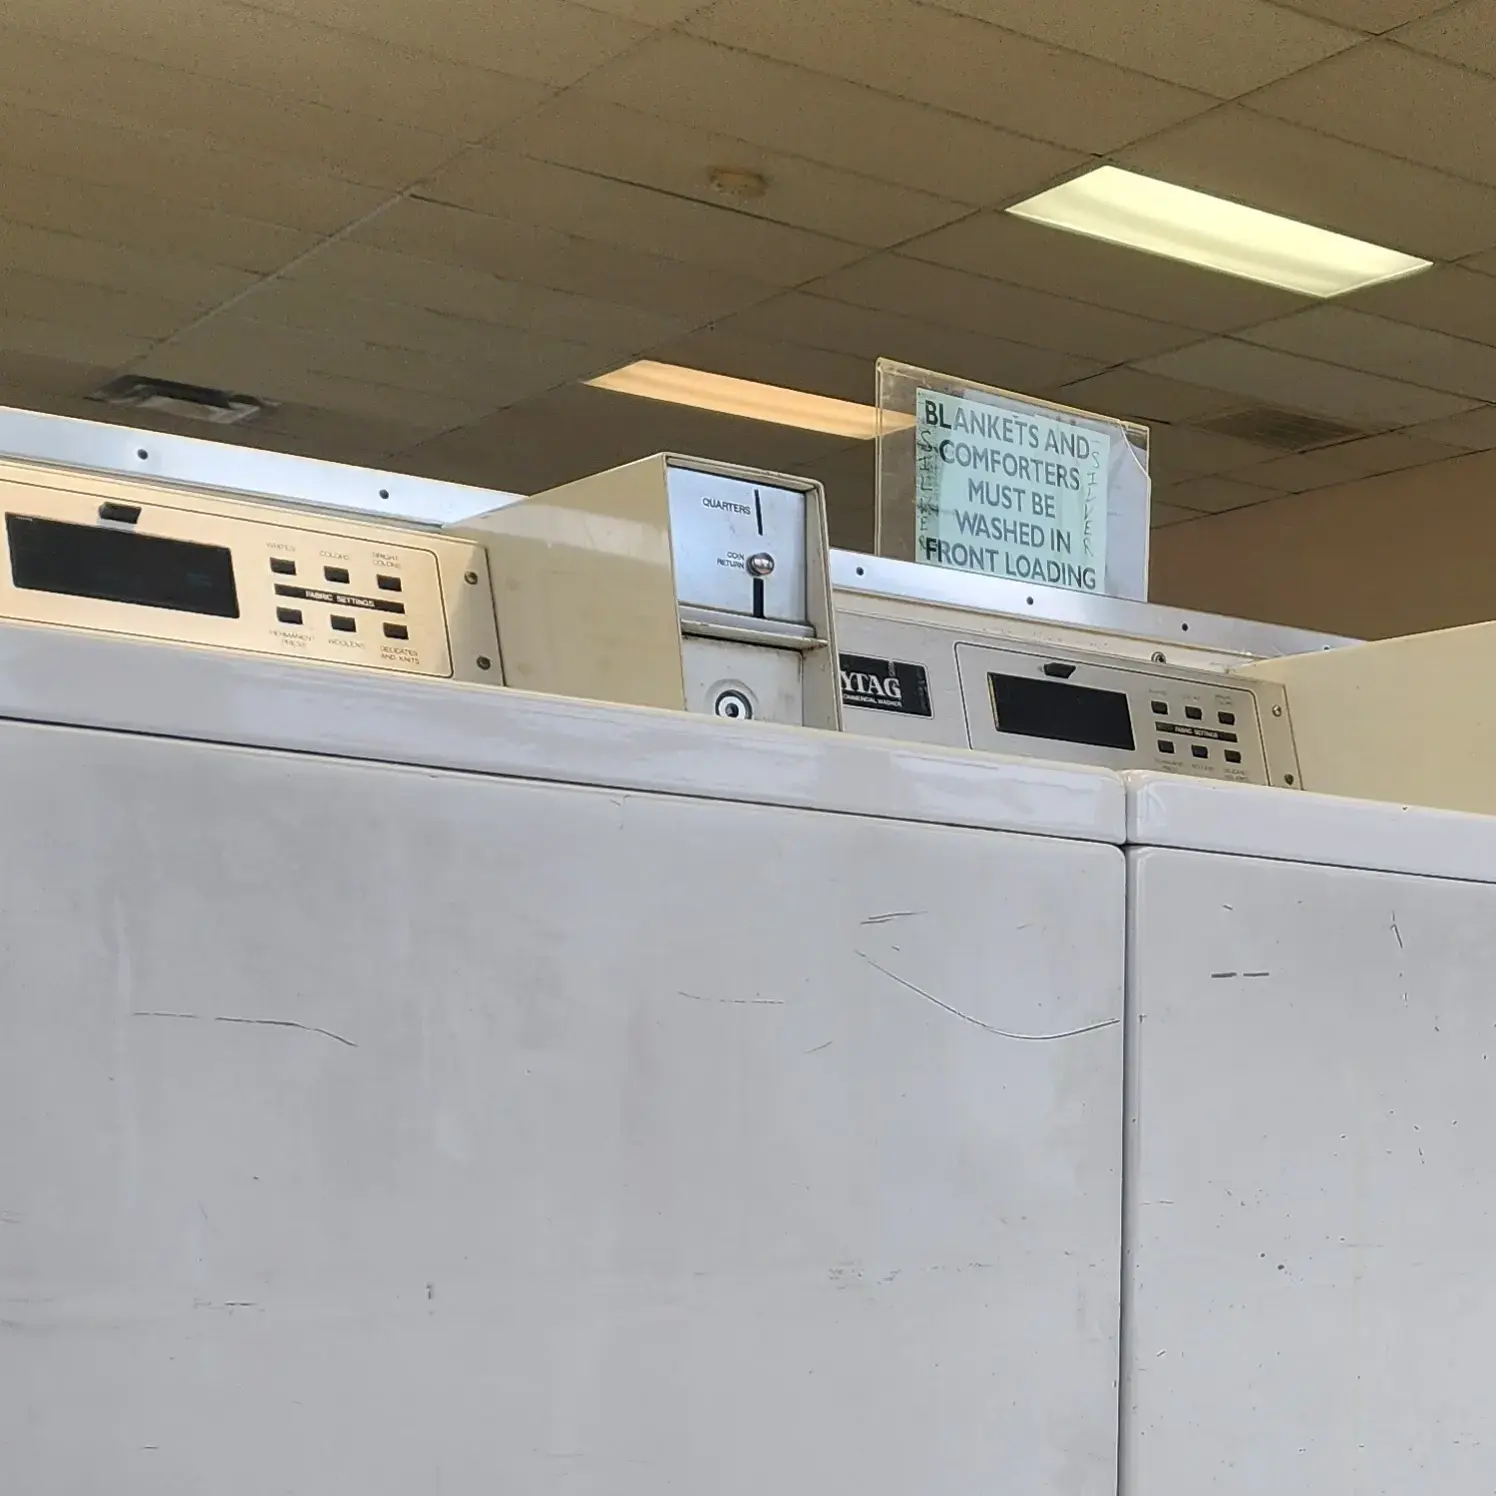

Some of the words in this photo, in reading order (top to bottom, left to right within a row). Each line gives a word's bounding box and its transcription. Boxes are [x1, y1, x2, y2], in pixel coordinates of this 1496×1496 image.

[924, 399, 1040, 449] BLANKETS
[1044, 428, 1090, 460] AND
[938, 438, 1081, 491] COMFORTERS
[702, 497, 751, 516] QUARTERS
[967, 478, 1027, 512] MUST
[1032, 493, 1056, 519] BE
[954, 508, 1046, 549] WASHED
[1050, 527, 1072, 554] IN
[716, 558, 745, 570] RETURN
[727, 551, 745, 561] COIN
[925, 537, 999, 573] FRONT
[1005, 554, 1097, 591] LOADING
[305, 590, 334, 602] FABRIC
[336, 595, 376, 608] SETTINGS
